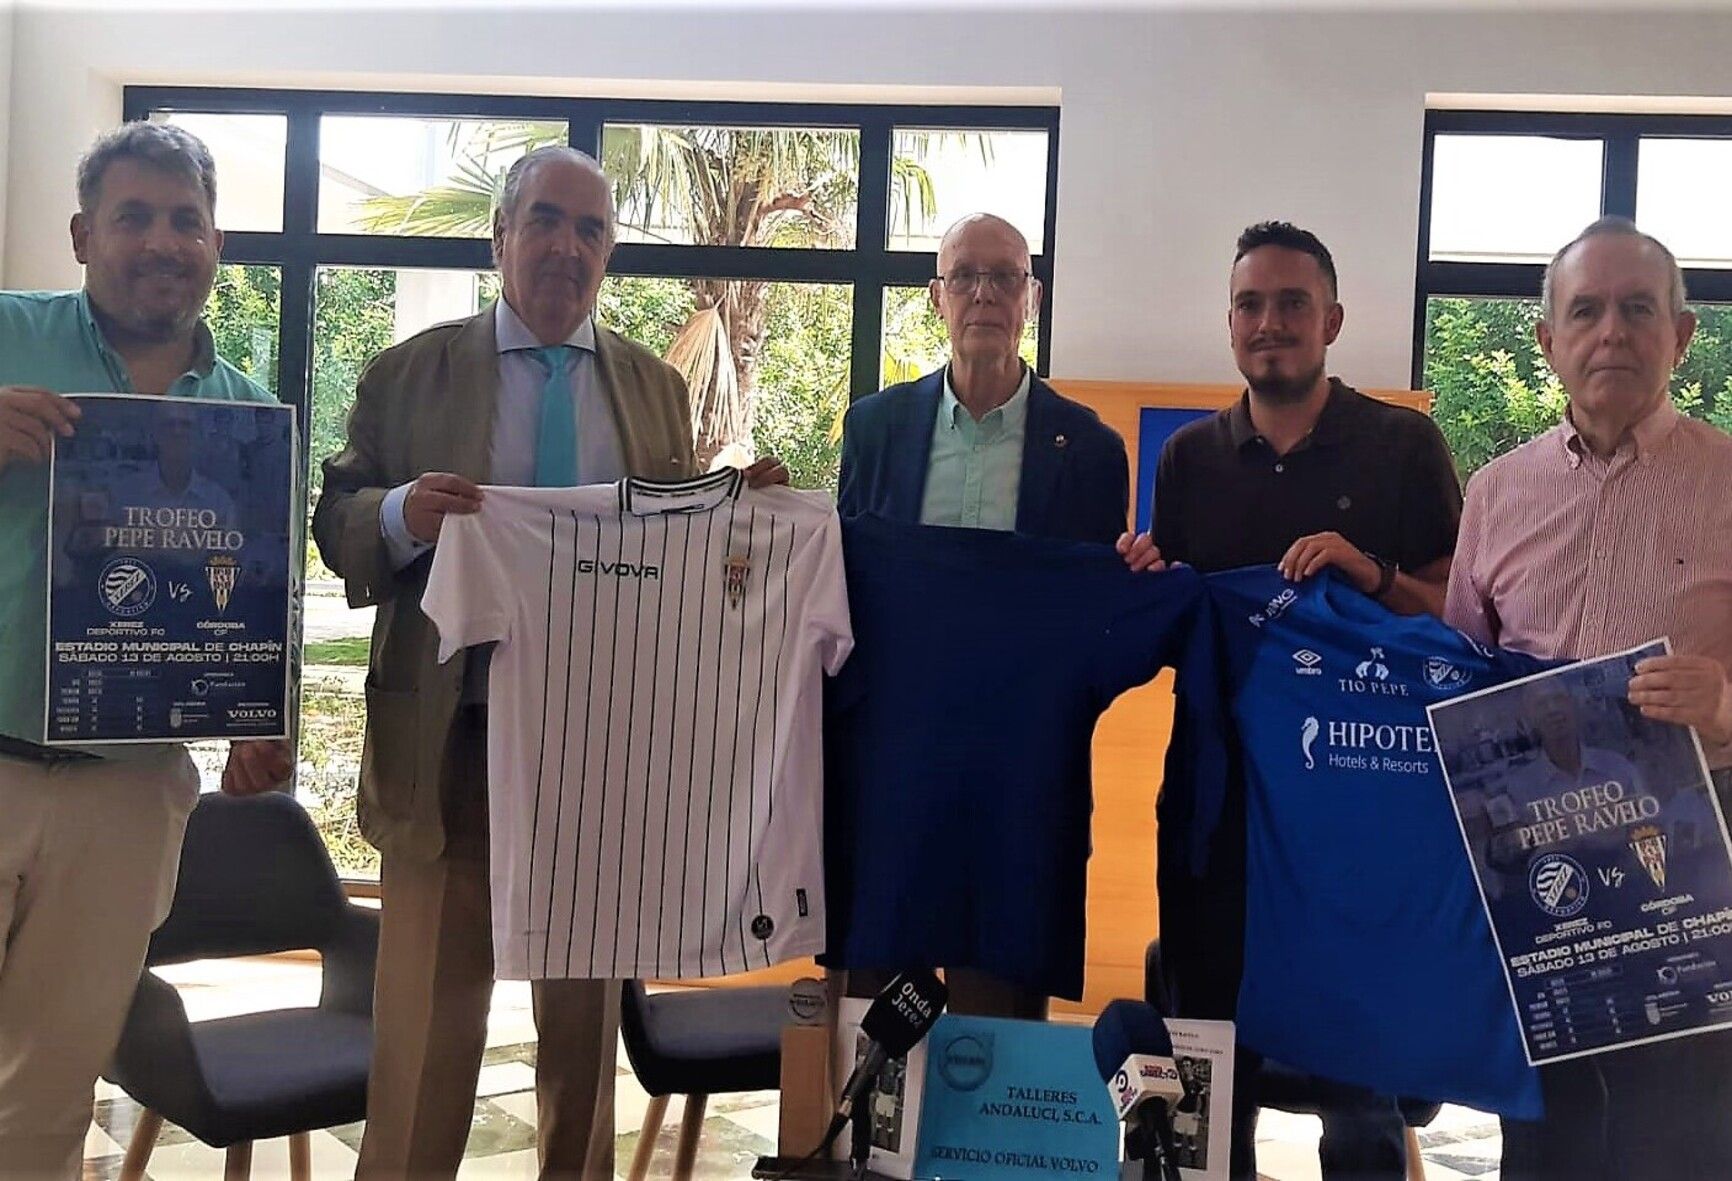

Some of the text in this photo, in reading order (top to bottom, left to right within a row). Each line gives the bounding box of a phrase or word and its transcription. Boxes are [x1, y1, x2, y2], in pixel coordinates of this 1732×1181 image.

[124, 506, 216, 528] TROFEO
[104, 526, 244, 550] PEPE RAVELO
[578, 560, 659, 580] GIVOVA
[55, 640, 282, 652] ESTADIO MUNICIPAL DE CHAPÍN
[121, 653, 139, 663] 13
[143, 653, 161, 663] DE
[166, 653, 221, 663] AGOSTO
[1295, 666, 1322, 676] umbro
[1338, 679, 1409, 697] TIO PEPE
[226, 709, 277, 719] VOLVO
[1328, 721, 1438, 753] HIPOTE
[1328, 753, 1429, 774] Hotels & Resorts
[1526, 781, 1623, 821] TROFEO
[1518, 796, 1660, 850] PEPE RAVELO
[1510, 945, 1571, 967] ESTADIO
[1574, 928, 1655, 953] MUNICIPAL
[1657, 921, 1679, 935] DE
[1577, 953, 1595, 965] 13
[1599, 948, 1618, 959] DE
[1622, 934, 1679, 955] AGOSTO
[902, 982, 931, 1018] Onda
[1007, 1086, 1077, 1104] TALLERES
[1063, 1109, 1103, 1124] S.C.A.
[932, 1146, 1098, 1173] SERVICIO OFICIAL VOLVO
